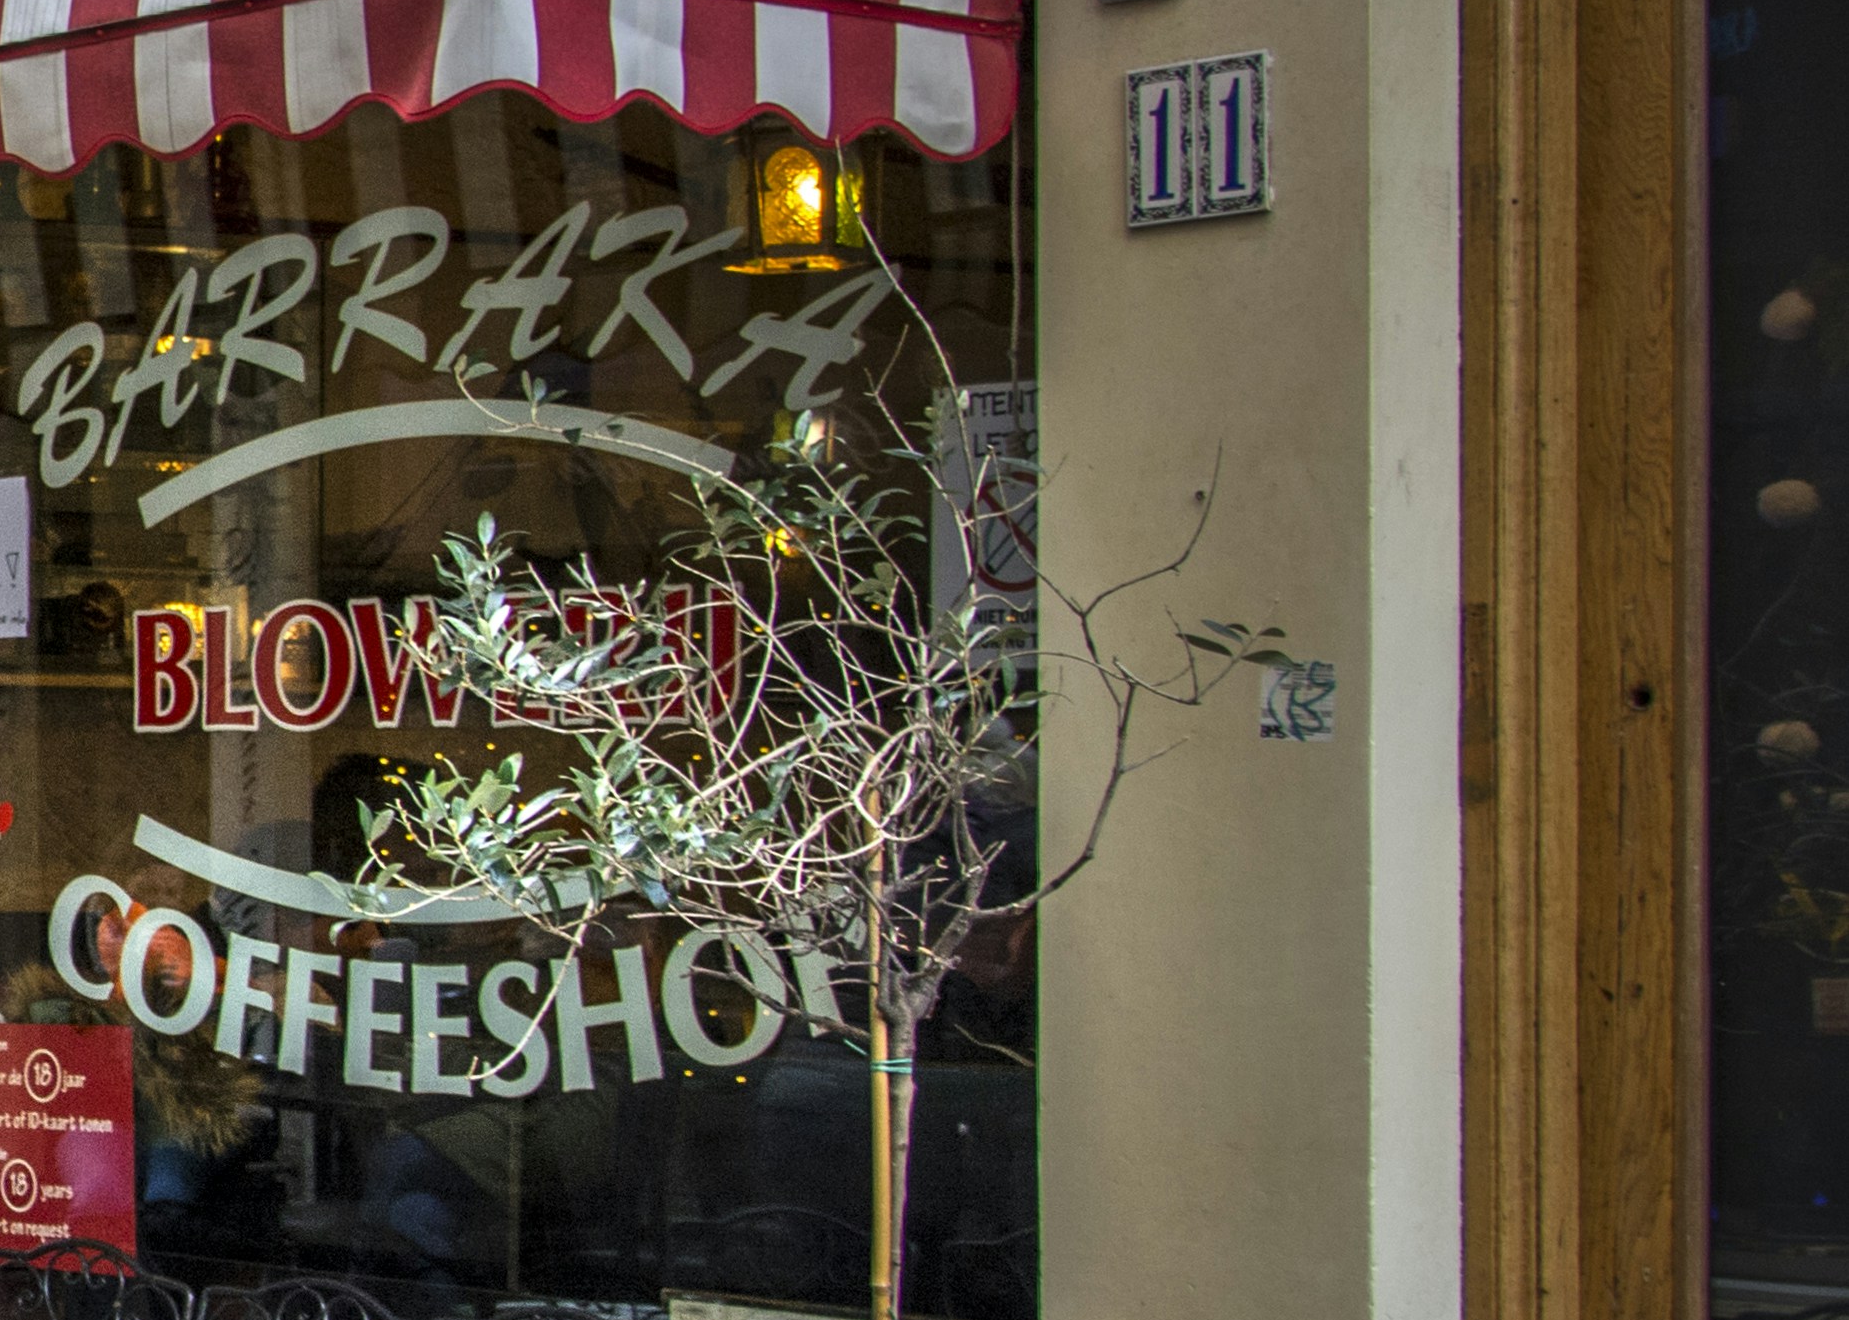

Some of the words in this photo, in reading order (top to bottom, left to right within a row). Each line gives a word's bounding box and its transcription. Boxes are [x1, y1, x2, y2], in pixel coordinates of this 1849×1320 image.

[16, 200, 897, 490] BARRAKA
[46, 873, 871, 1100] COFFEESHOP
[33, 1062, 53, 1087] 18
[61, 1070, 86, 1093] jaar
[13, 1110, 26, 1129] of
[8, 1171, 28, 1196] 18
[41, 1184, 73, 1202] years
[9, 1222, 25, 1236] on
[26, 1221, 71, 1245] request
